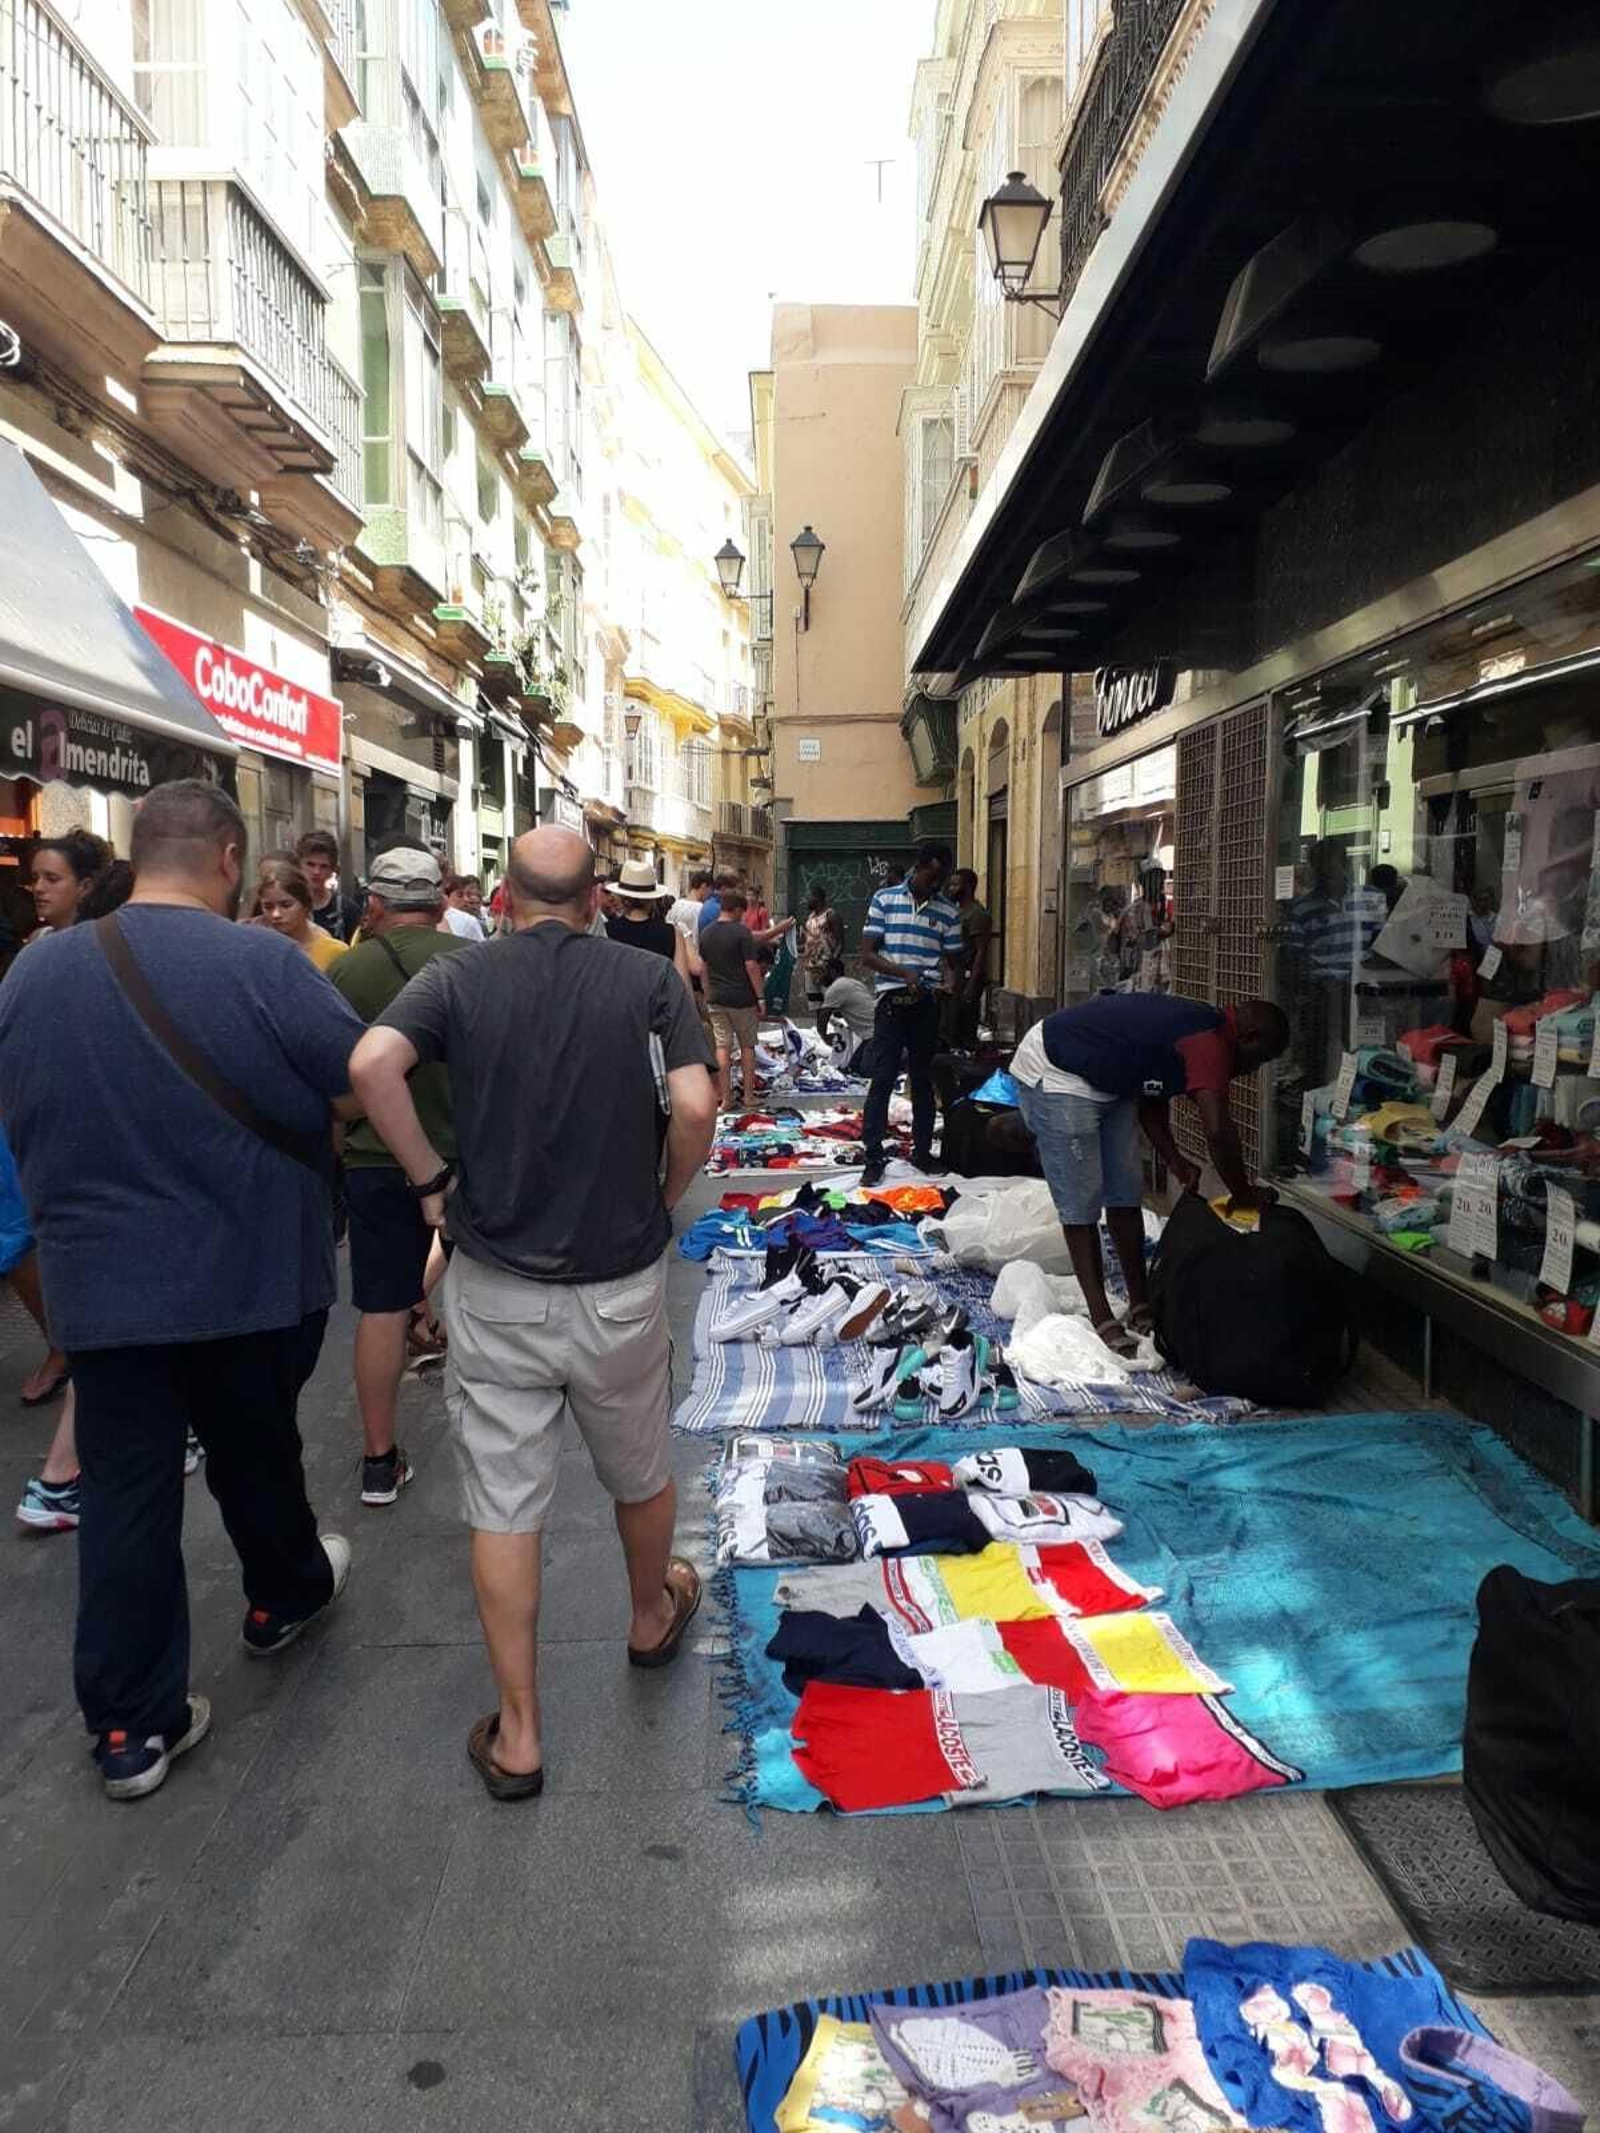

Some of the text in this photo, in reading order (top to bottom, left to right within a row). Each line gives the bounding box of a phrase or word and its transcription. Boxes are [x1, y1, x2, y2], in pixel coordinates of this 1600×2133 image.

[195, 646, 308, 737] CoboConfort
[10, 719, 33, 759] el
[937, 1715, 972, 1770] LACOSTE
[1052, 1720, 1094, 1771] LACOSTE
